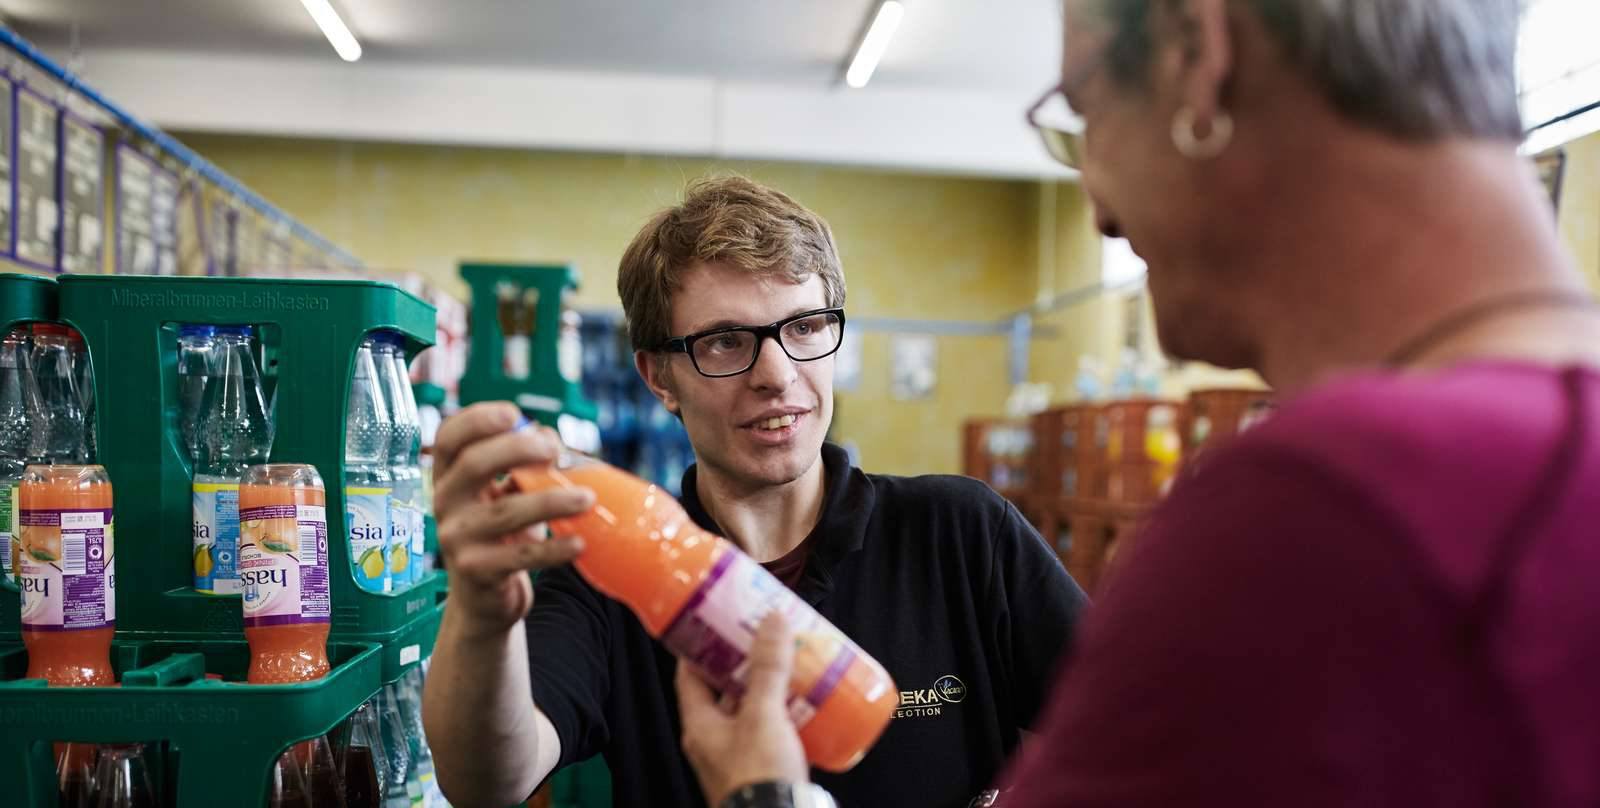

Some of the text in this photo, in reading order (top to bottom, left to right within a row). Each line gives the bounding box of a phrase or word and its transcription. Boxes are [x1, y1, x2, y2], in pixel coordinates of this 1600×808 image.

[351, 523, 383, 540] sia
[20, 578, 50, 597] ha
[895, 688, 939, 705] EKA
